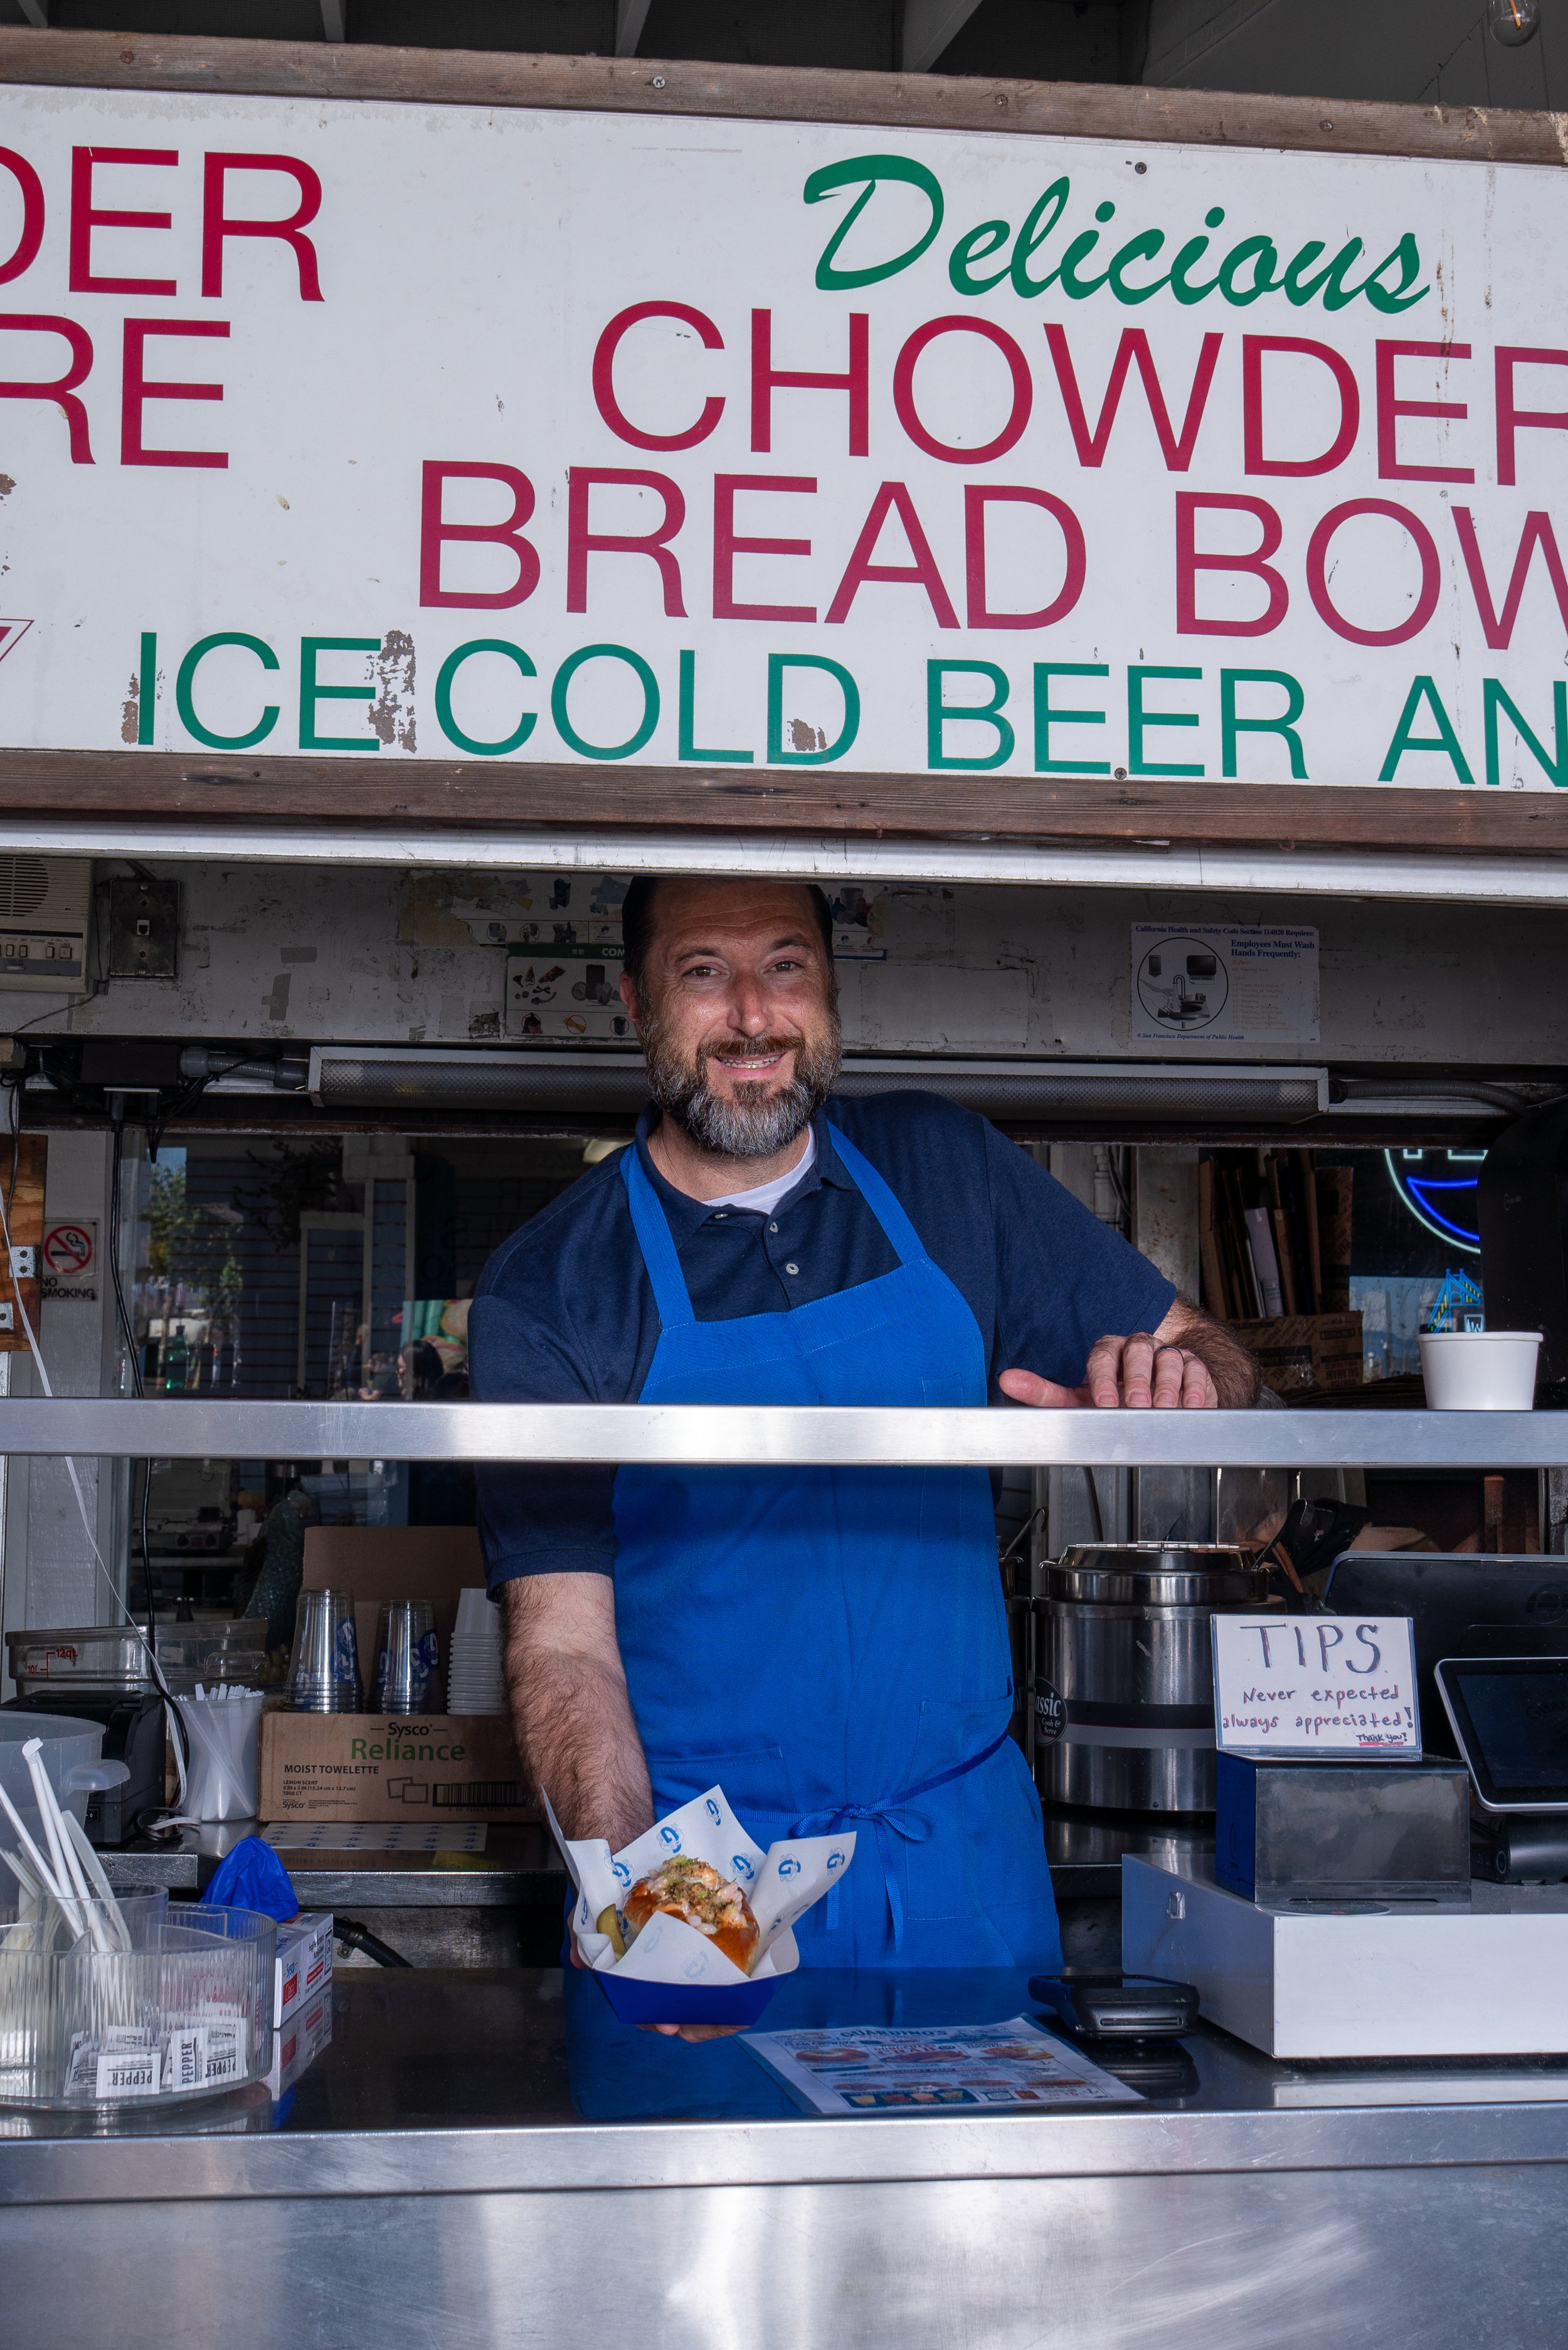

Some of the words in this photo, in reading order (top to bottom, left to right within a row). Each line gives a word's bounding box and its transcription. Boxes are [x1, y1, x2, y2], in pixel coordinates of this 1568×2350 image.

[804, 155, 1429, 312] Delicious
[593, 301, 1568, 485] CHOWDER
[420, 461, 1085, 628] BREAD
[139, 633, 381, 750] ICE
[435, 640, 859, 764] COLD
[928, 660, 1307, 778] BEER
[1380, 676, 1568, 786] AN
[1231, 939, 1271, 949] Employees
[1258, 950, 1300, 958] Frequently:
[41, 1288, 95, 1298] SMOKING
[1239, 1622, 1380, 1674] TIPS
[28, 1665, 40, 1674] 10L
[1243, 1687, 1297, 1703] Never
[1311, 1684, 1399, 1709] expected
[1042, 1717, 1054, 1727] Cook
[1054, 1720, 1061, 1728] &
[1222, 1713, 1279, 1733] always
[1296, 1706, 1414, 1736] appreciated!
[388, 1722, 430, 1738] Sysco
[1044, 1726, 1057, 1735] Serve
[1355, 1733, 1385, 1742] Thank
[351, 1738, 466, 1761] Reliance
[284, 1764, 317, 1774] MOIST
[319, 1765, 379, 1774] TOWELETTE
[282, 1801, 304, 1809] Sysco
[182, 2042, 194, 2085] PEPPER
[206, 2057, 236, 2078] PEPPER
[113, 2070, 152, 2086] PEPPER
